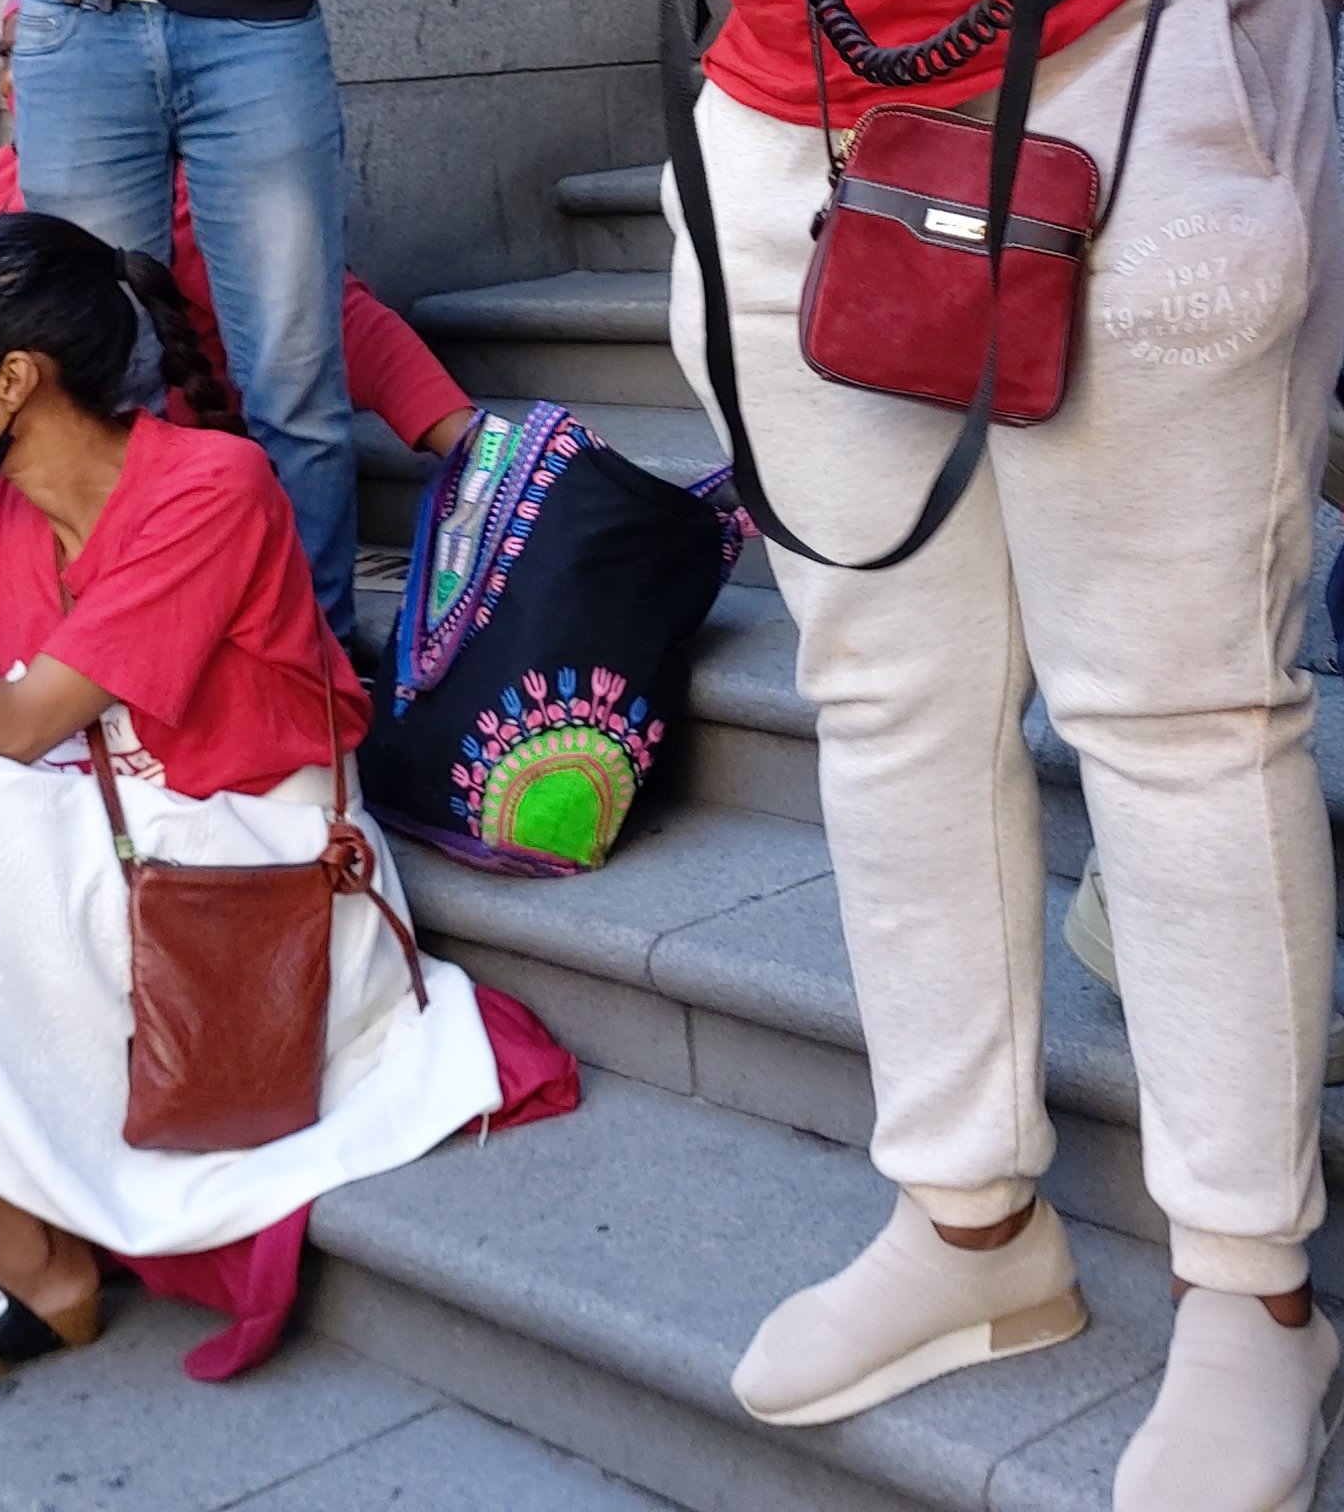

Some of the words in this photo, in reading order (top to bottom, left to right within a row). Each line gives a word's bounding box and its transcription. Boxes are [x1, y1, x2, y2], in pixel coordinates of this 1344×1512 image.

[1114, 234, 1160, 277] NEW
[1160, 214, 1223, 240] YORK
[1162, 285, 1233, 324] USA
[1130, 325, 1260, 366] BROOKLYN
